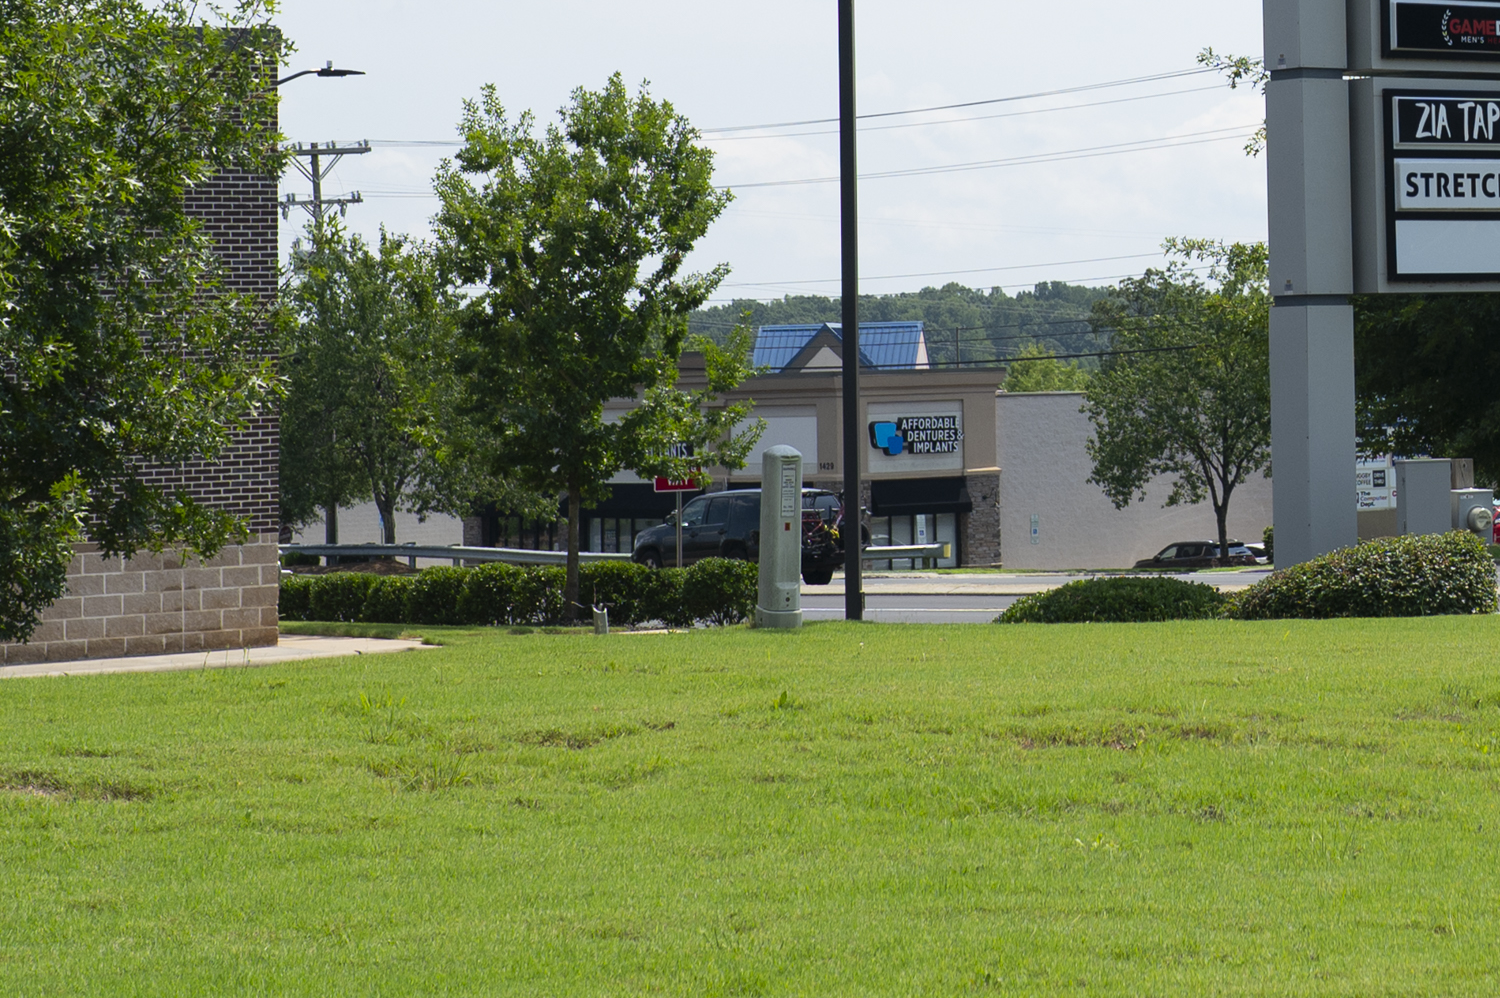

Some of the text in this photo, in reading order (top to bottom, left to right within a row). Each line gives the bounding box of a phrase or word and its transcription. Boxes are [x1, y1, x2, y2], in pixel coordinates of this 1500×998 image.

[1461, 36, 1484, 44] MEN'S
[1415, 102, 1451, 139] ZIA
[902, 418, 959, 430] AFFORDABLE
[908, 429, 964, 441] DENTURES &
[914, 441, 958, 453] IMPLANTS
